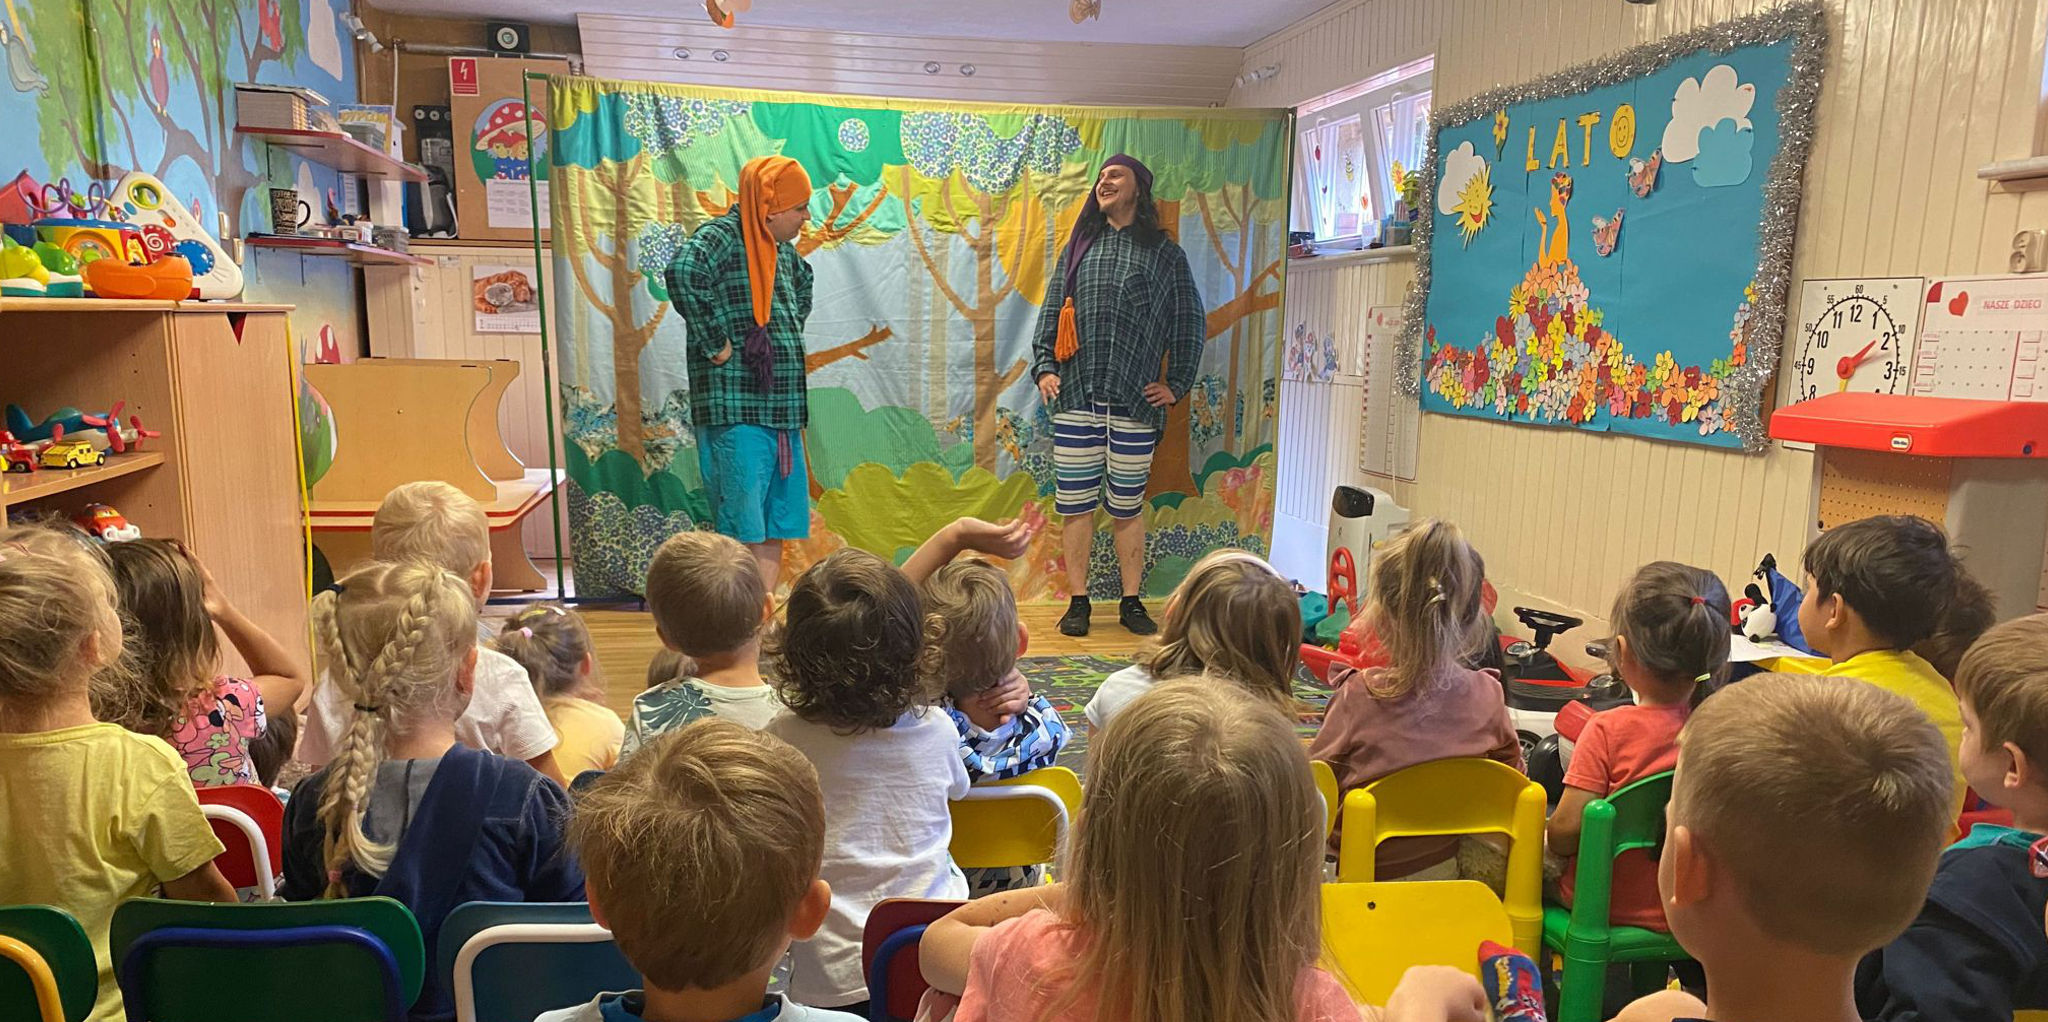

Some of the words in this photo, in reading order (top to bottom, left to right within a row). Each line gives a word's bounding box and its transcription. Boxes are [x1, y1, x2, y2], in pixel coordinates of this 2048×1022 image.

[1526, 103, 1636, 171] LATO
[1855, 284, 1863, 294] 60
[1827, 295, 1835, 304] 55
[1883, 295, 1888, 304] 5
[1984, 300, 2009, 310] NASZE
[2014, 299, 2042, 309] DZIECI
[1833, 311, 1843, 329] 11
[1850, 304, 1863, 323] 12
[1872, 311, 1878, 330] 1
[1805, 323, 1812, 333] 50
[1898, 324, 1906, 334] 10
[1816, 331, 1829, 348] 10
[1881, 332, 1890, 350] 2
[1794, 361, 1801, 370] 45
[1807, 358, 1815, 375] 9
[1884, 361, 1893, 380] 3
[1899, 366, 1907, 376] 15
